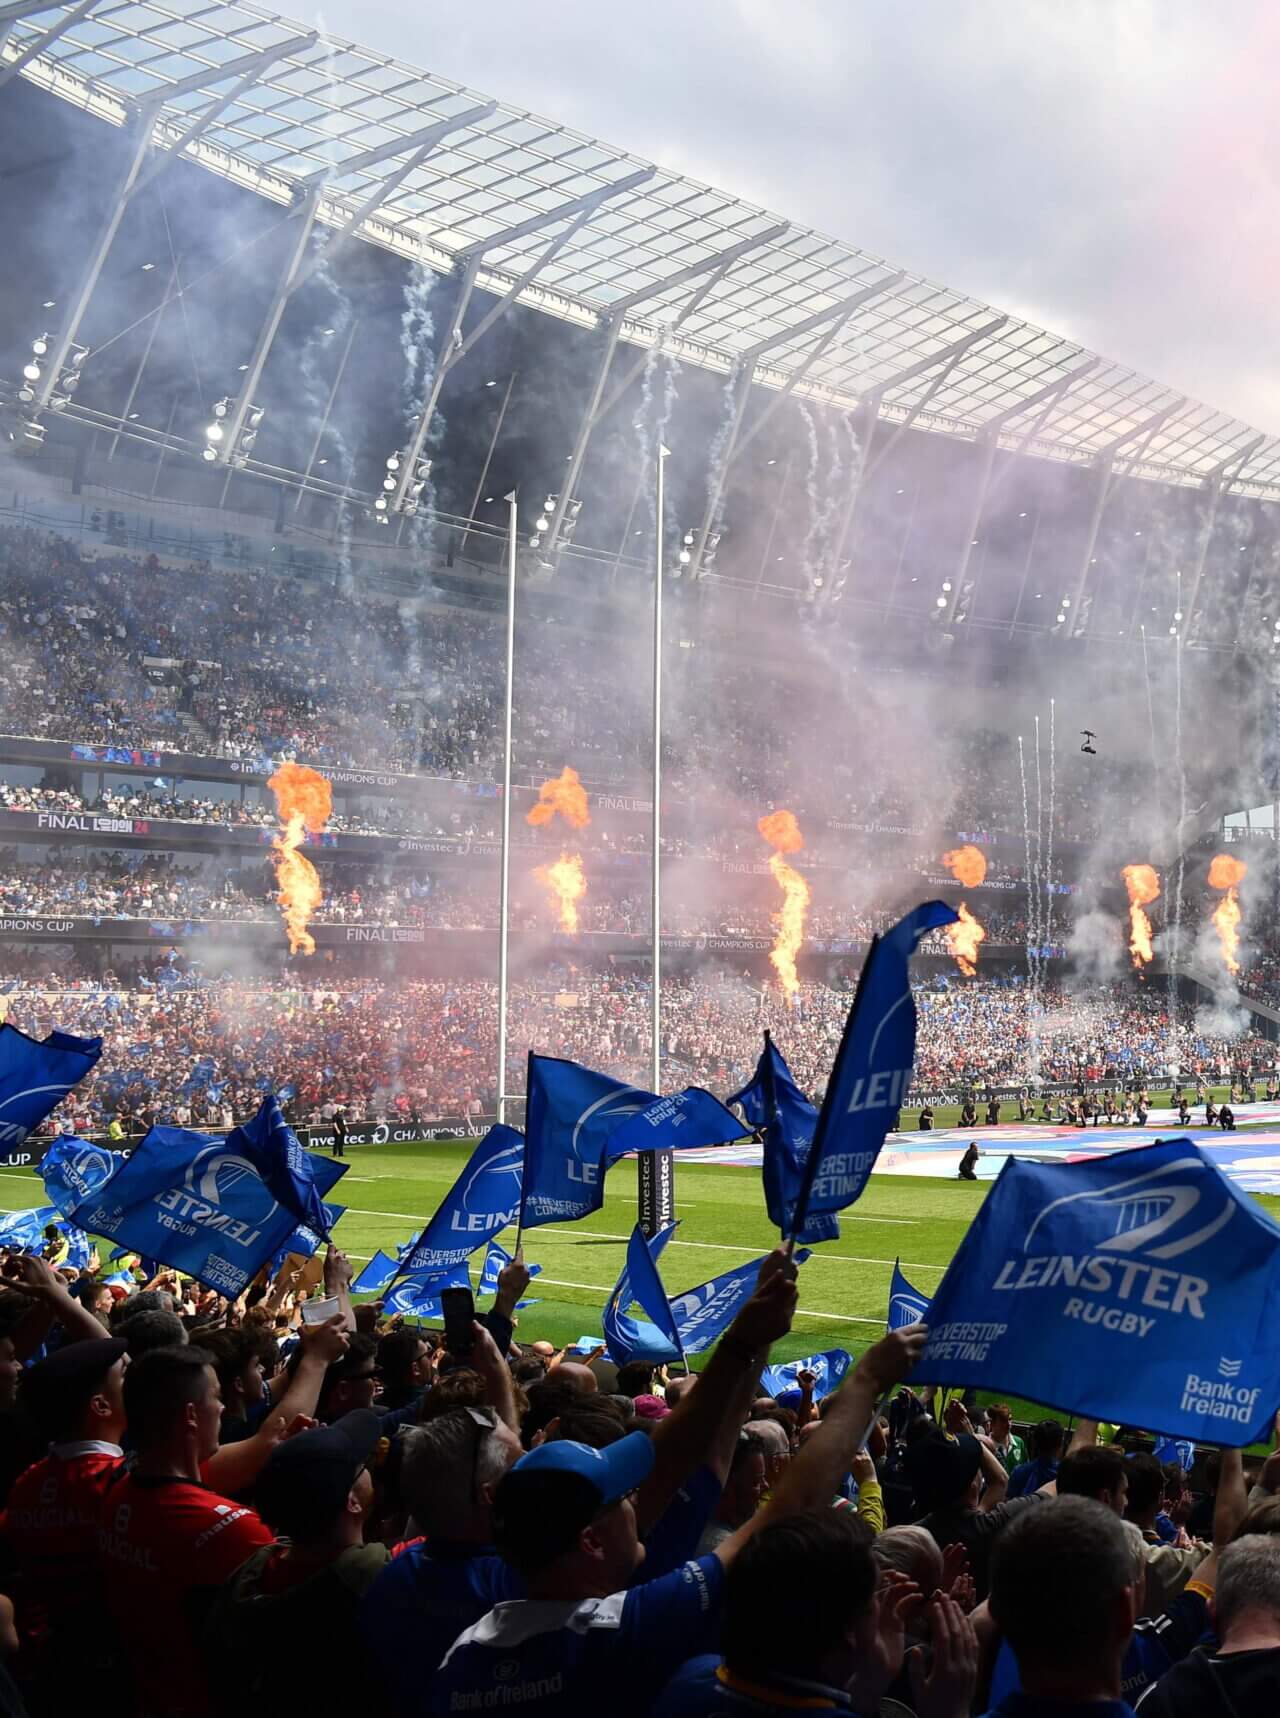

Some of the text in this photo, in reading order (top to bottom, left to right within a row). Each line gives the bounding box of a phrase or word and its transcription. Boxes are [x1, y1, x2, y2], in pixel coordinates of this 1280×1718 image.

[323, 770, 375, 785] HAMPIONS
[37, 814, 90, 831] FINAL
[46, 921, 75, 932] CUP
[346, 927, 390, 941] FINAL
[901, 1094, 959, 1109] CHAMPIONS
[309, 1133, 366, 1148] nvetec
[642, 1155, 651, 1221] Investec
[659, 1155, 670, 1221] Investec
[992, 1255, 1209, 1319] LEINSTER
[1063, 1297, 1156, 1337] RUGBY
[1185, 1374, 1262, 1405] Bank of
[1180, 1391, 1253, 1424] Ireland
